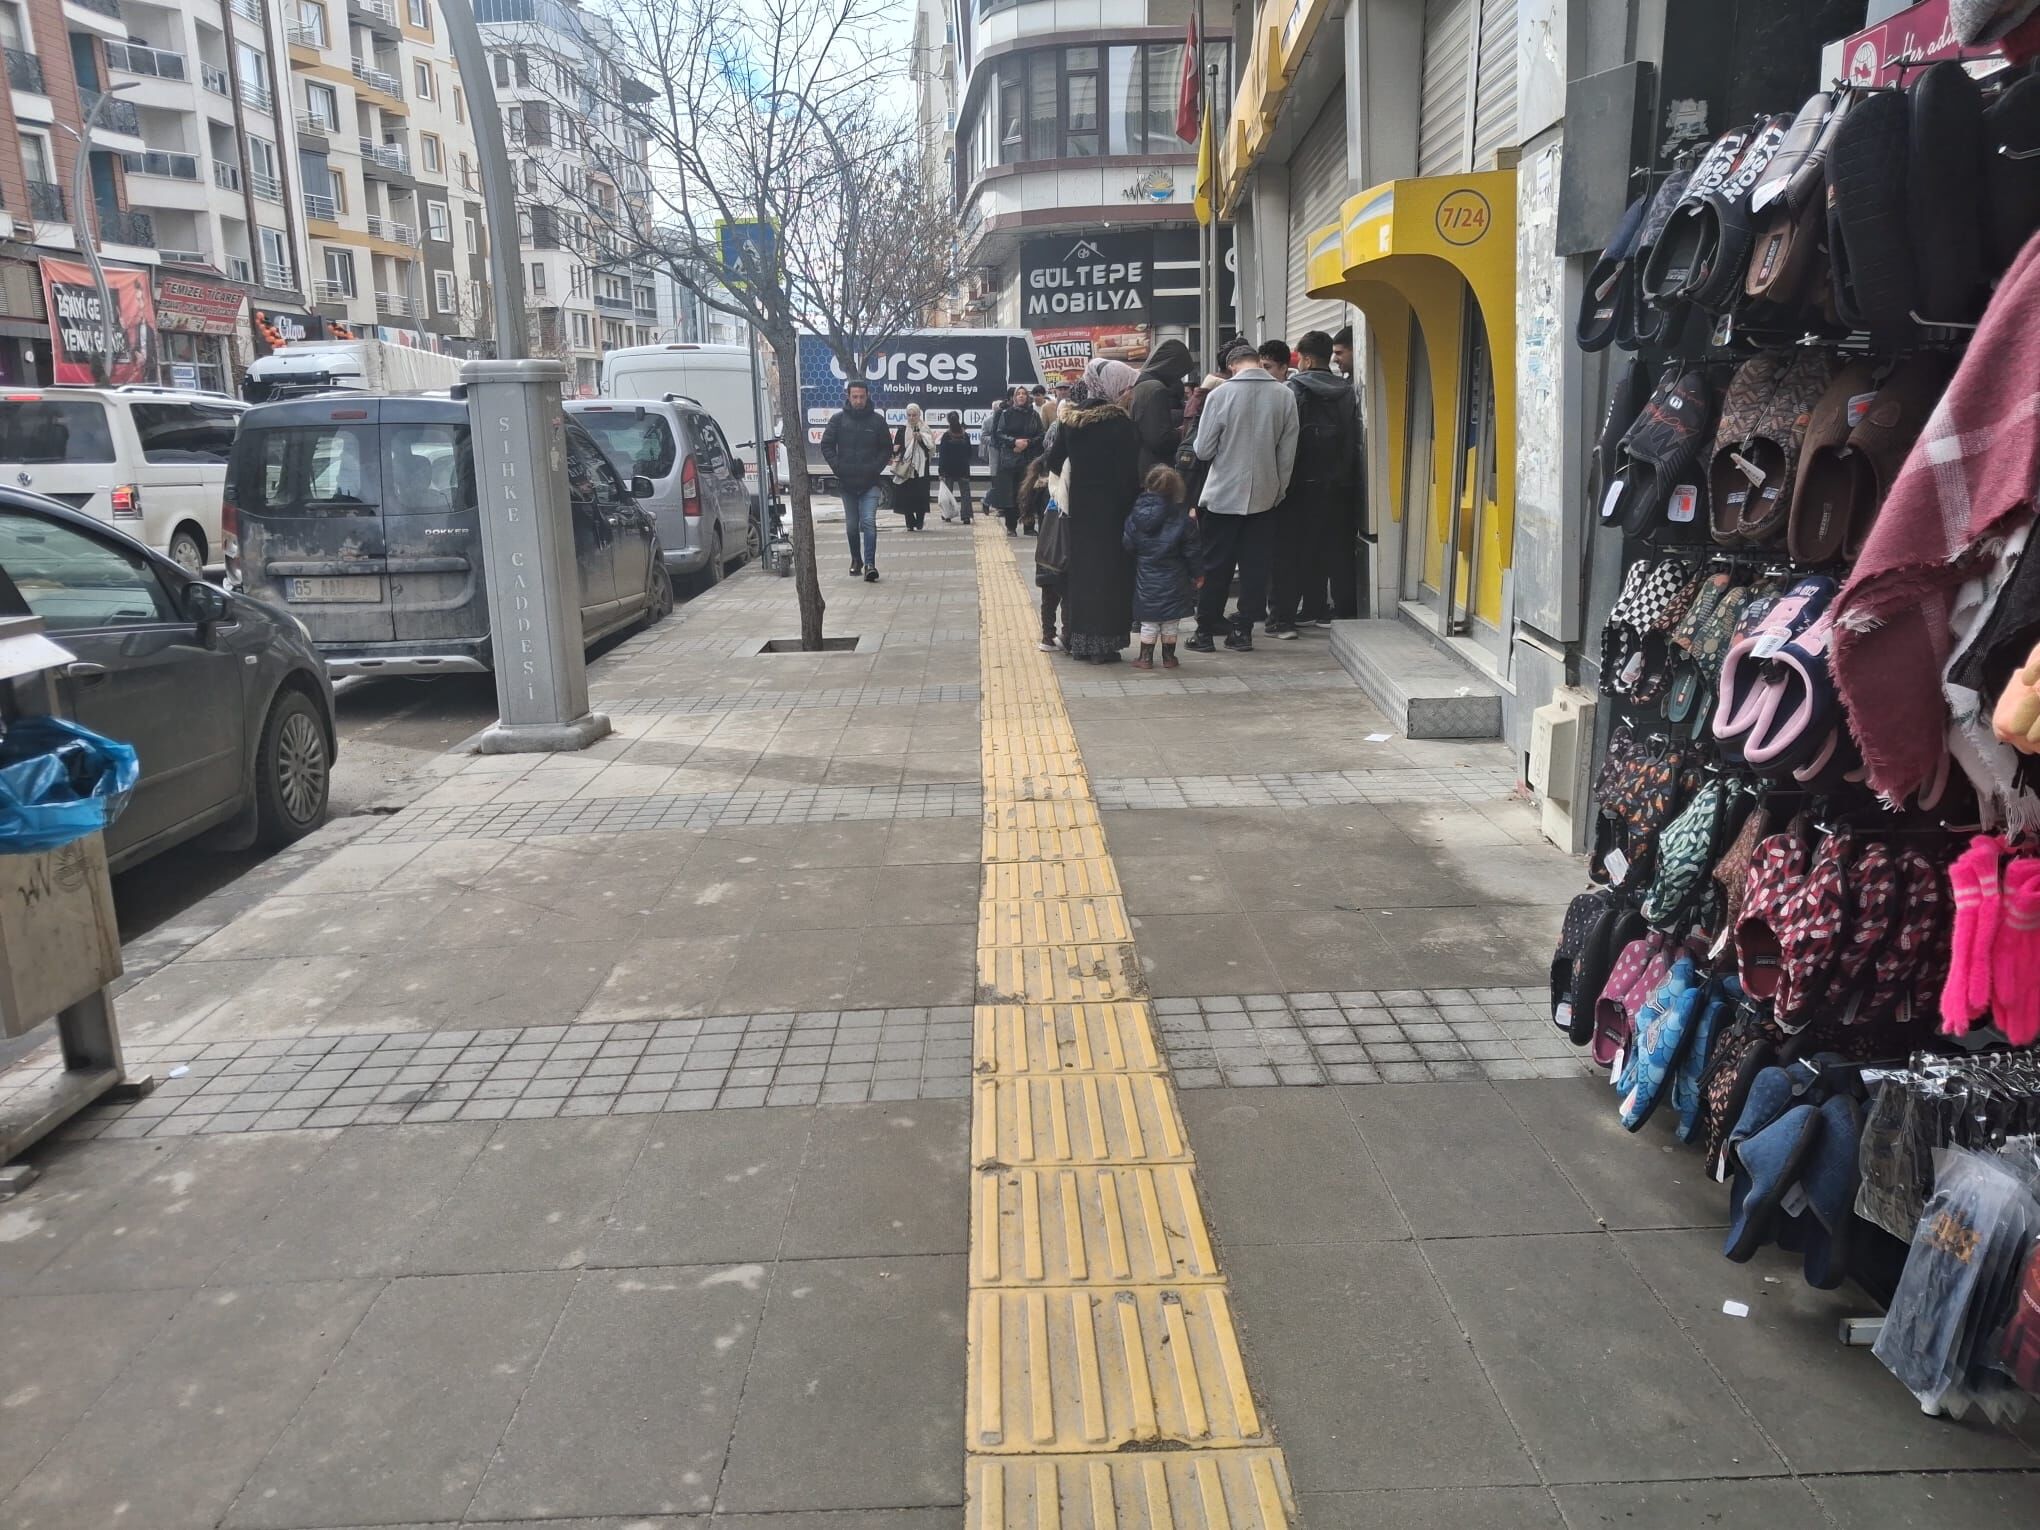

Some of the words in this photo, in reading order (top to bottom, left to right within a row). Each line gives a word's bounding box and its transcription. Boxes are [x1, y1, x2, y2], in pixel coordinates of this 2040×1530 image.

[1721, 127, 1790, 205] TYSON
[1443, 207, 1485, 229] 7/24
[1029, 261, 1143, 289] GÜLTEPE
[1028, 288, 1144, 315] MOBİLYA
[883, 383, 921, 393] Mobilya
[926, 383, 954, 393] Beyaz
[956, 384, 978, 395] Eşya
[294, 579, 313, 597] 65
[510, 551, 535, 701] CADDESİ
